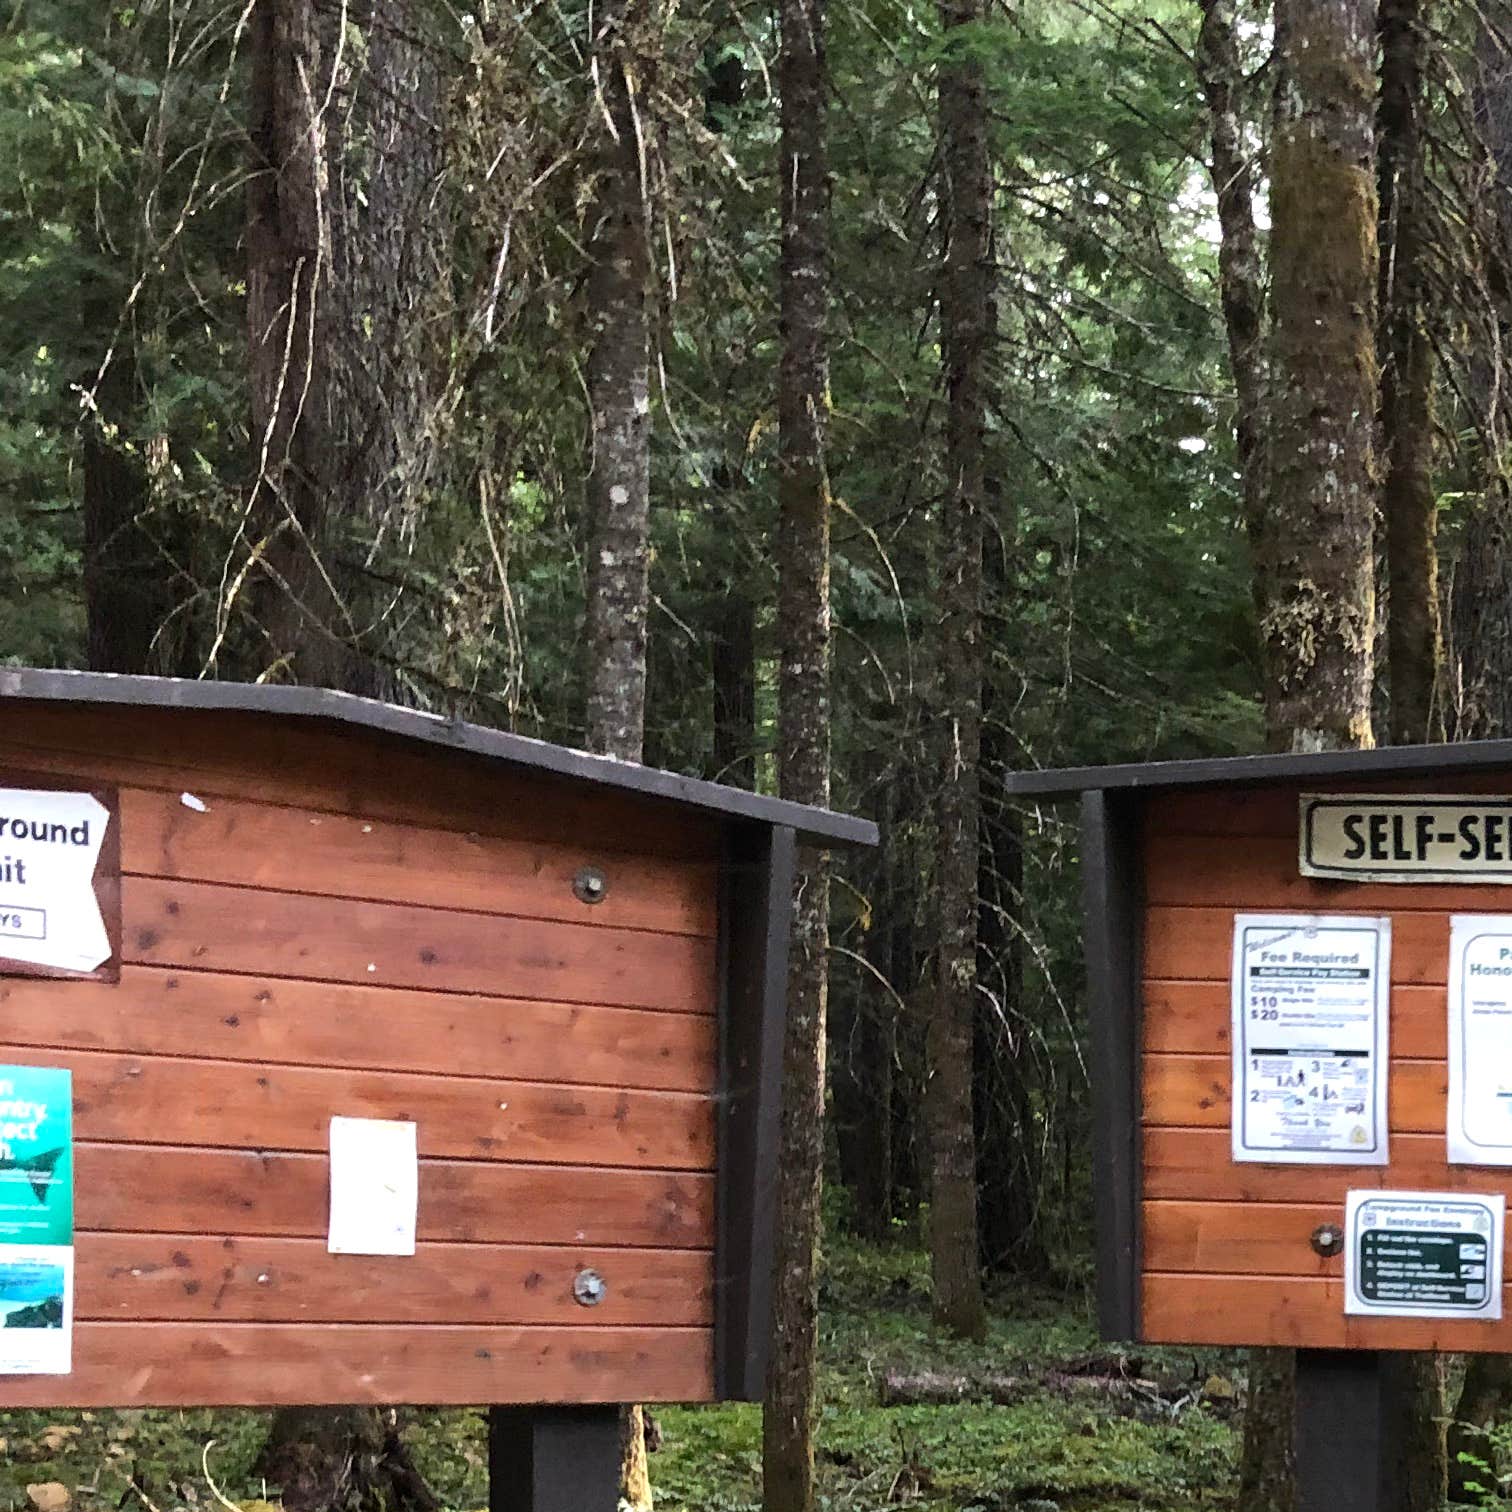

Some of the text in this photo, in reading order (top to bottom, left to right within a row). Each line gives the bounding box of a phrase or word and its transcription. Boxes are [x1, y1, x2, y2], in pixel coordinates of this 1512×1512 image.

[0, 855, 26, 884] it
[1261, 951, 1360, 965] Fee Required
[0, 1100, 49, 1125] ntry.
